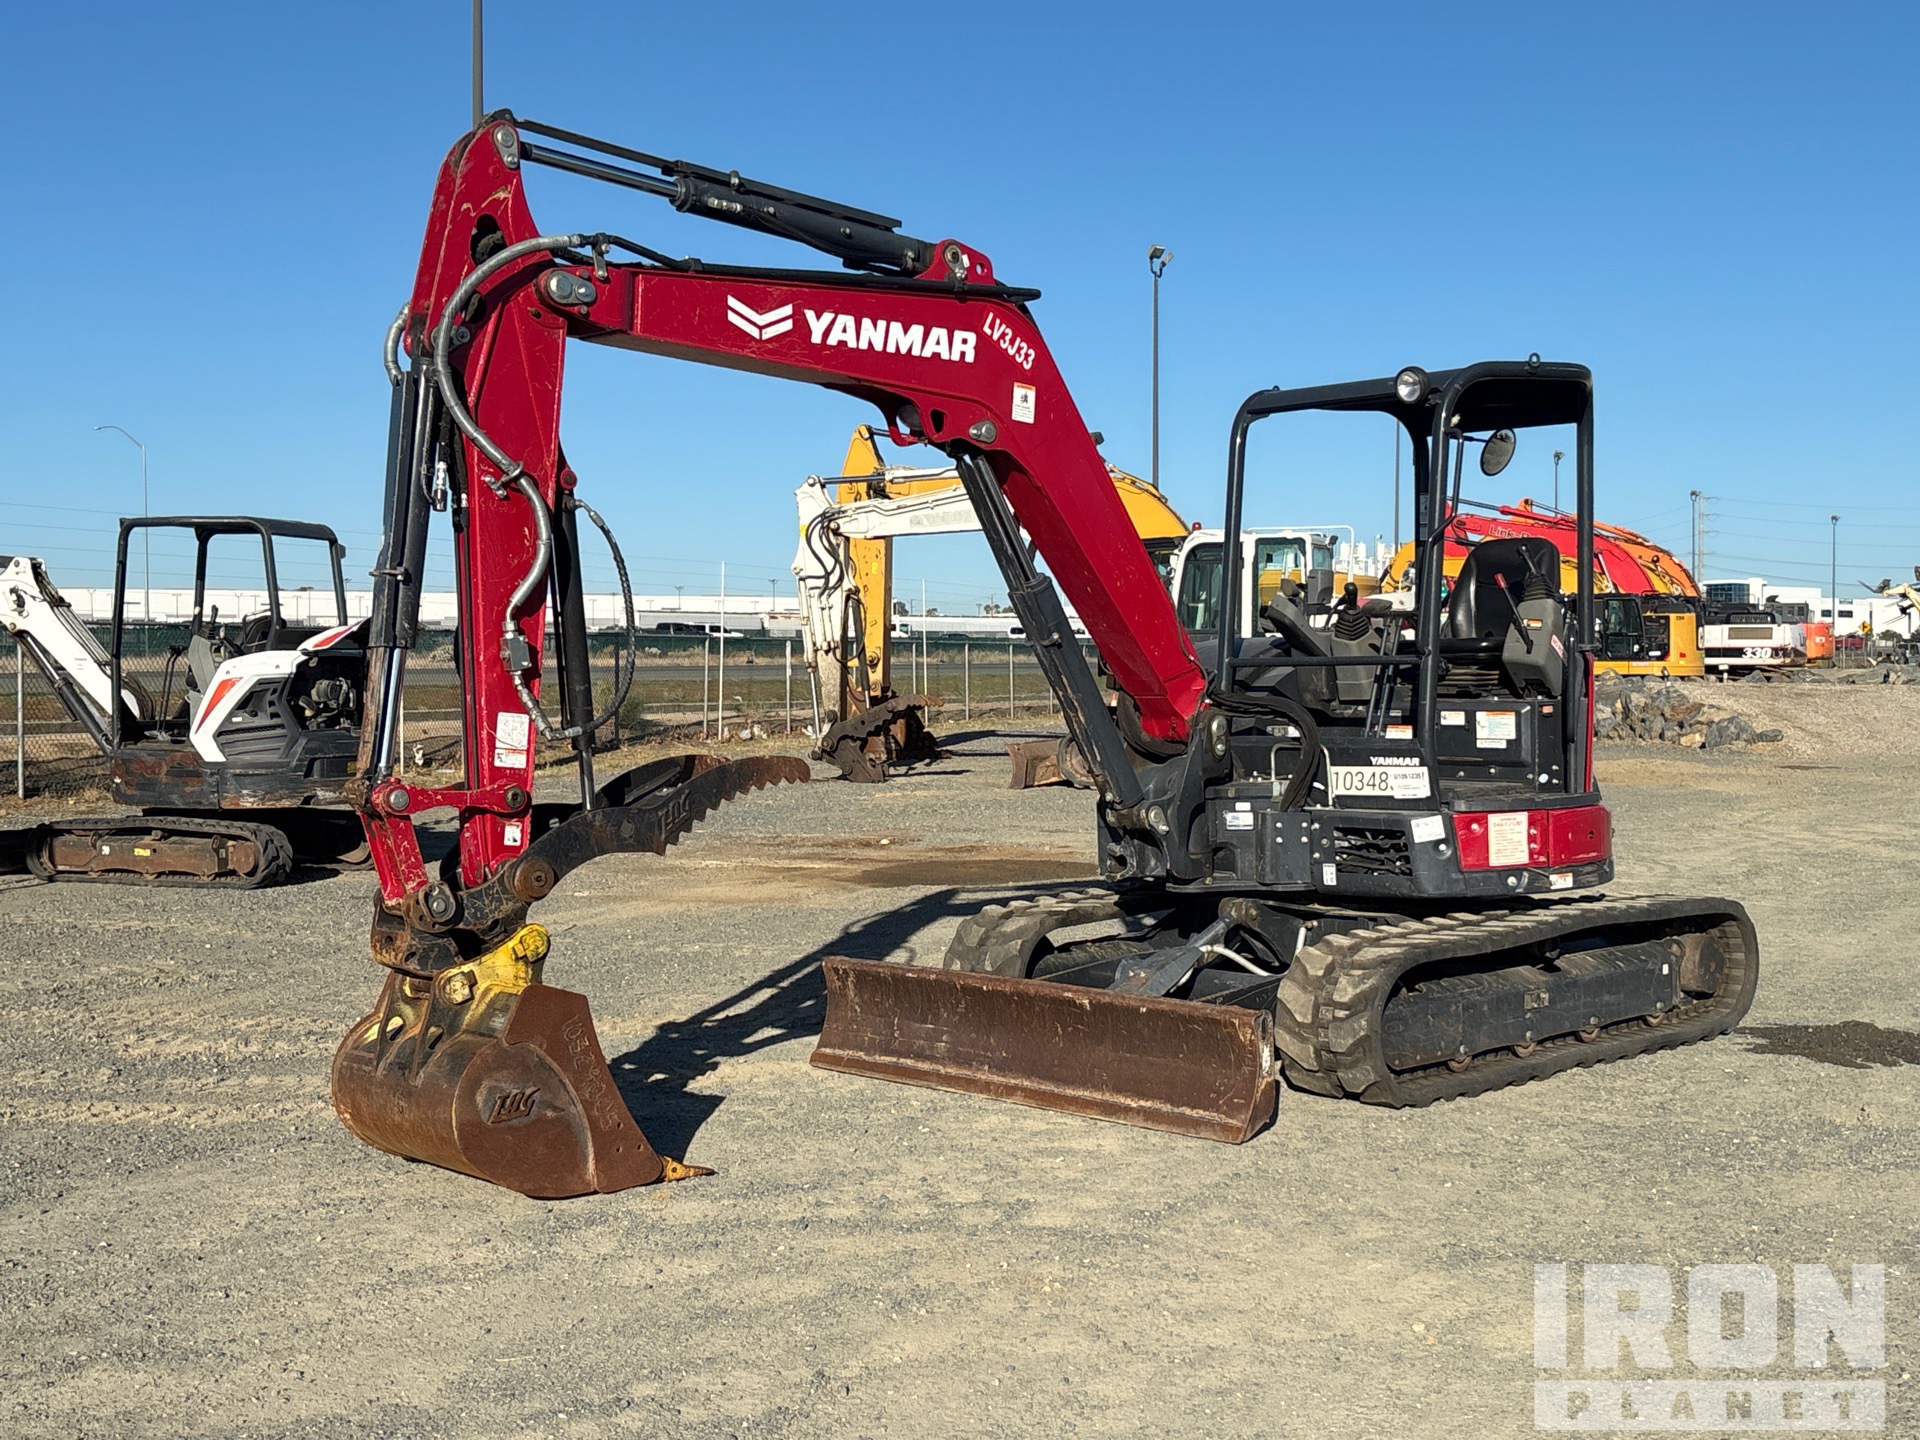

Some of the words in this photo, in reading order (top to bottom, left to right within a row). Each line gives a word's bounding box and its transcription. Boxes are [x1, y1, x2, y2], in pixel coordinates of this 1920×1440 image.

[803, 309, 977, 363] YANMAR
[982, 311, 1036, 370] LV3J33
[1741, 647, 1773, 659] 330
[1369, 756, 1420, 767] YANMAR
[1333, 771, 1394, 791] 10348
